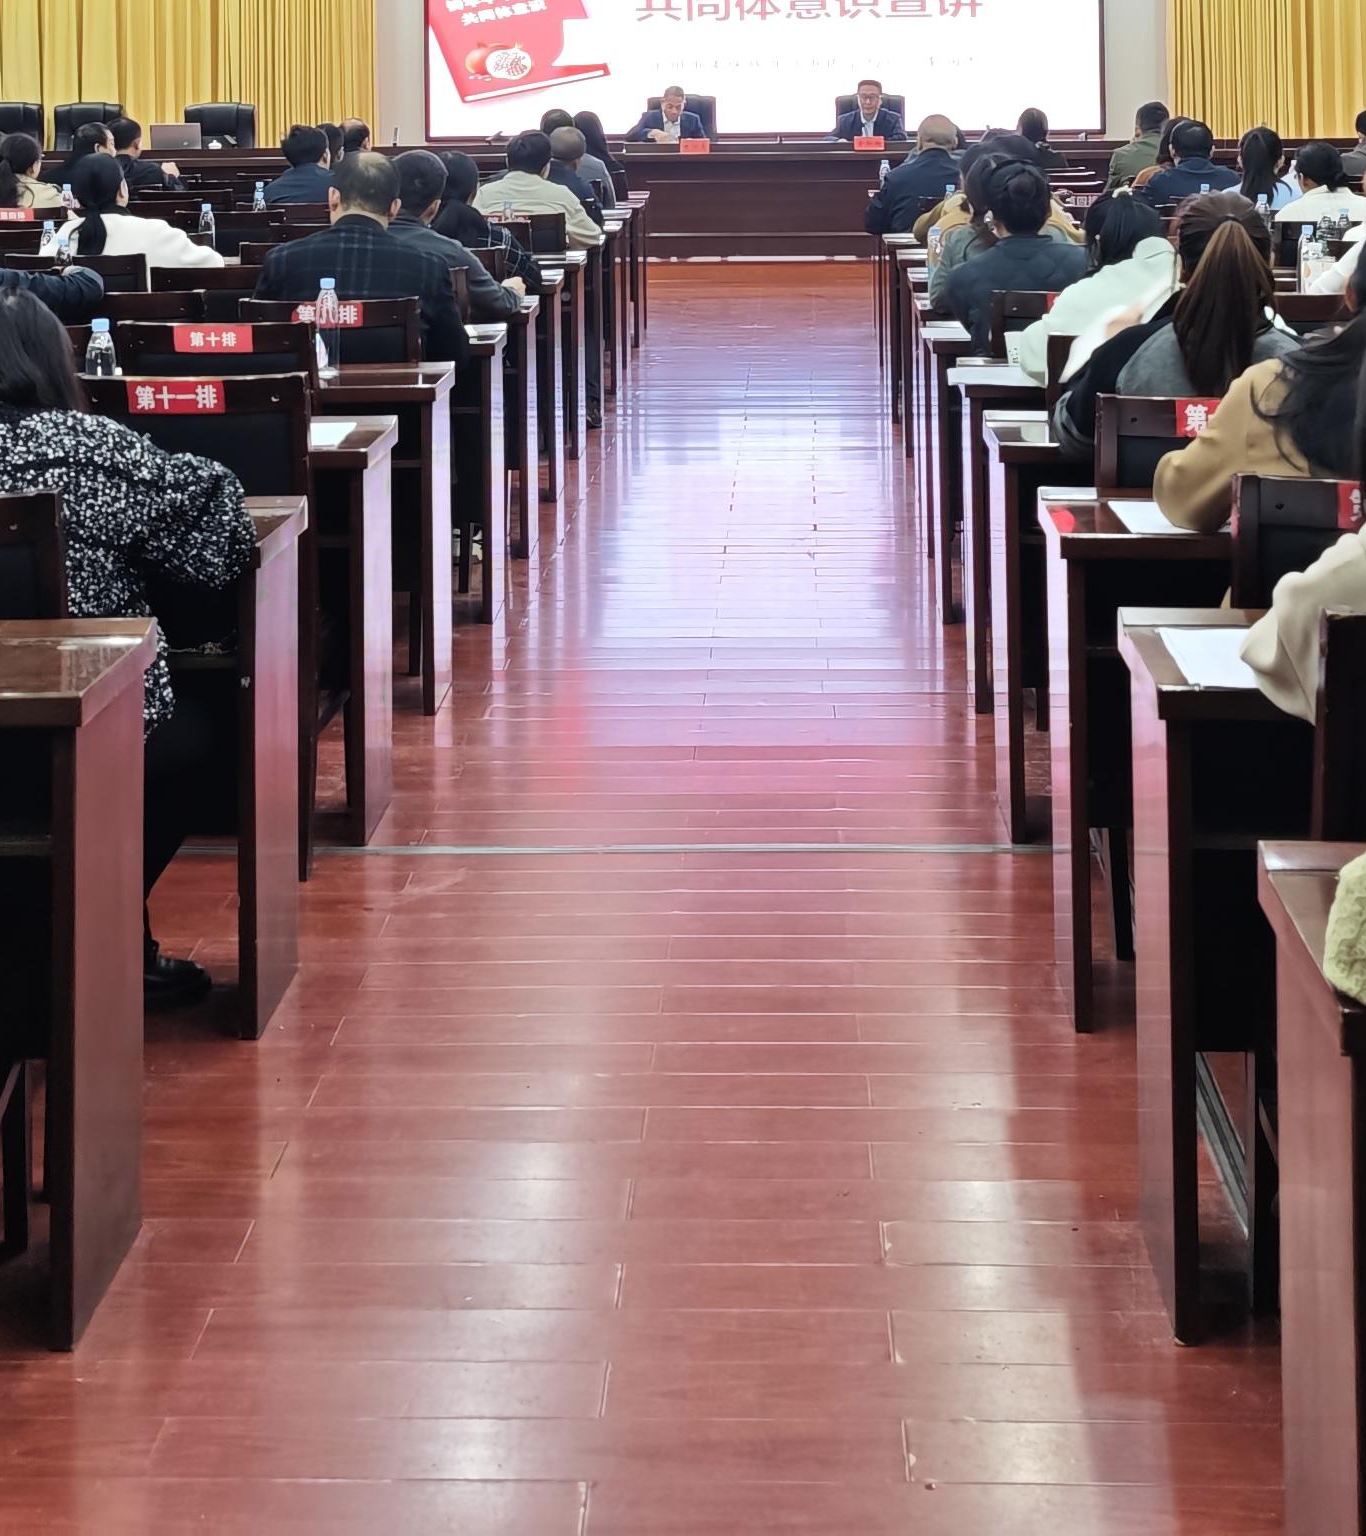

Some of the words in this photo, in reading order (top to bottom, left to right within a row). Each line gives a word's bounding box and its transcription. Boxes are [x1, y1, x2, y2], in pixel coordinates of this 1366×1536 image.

[189, 331, 237, 347] 第十排
[135, 384, 218, 410] 第十一排
